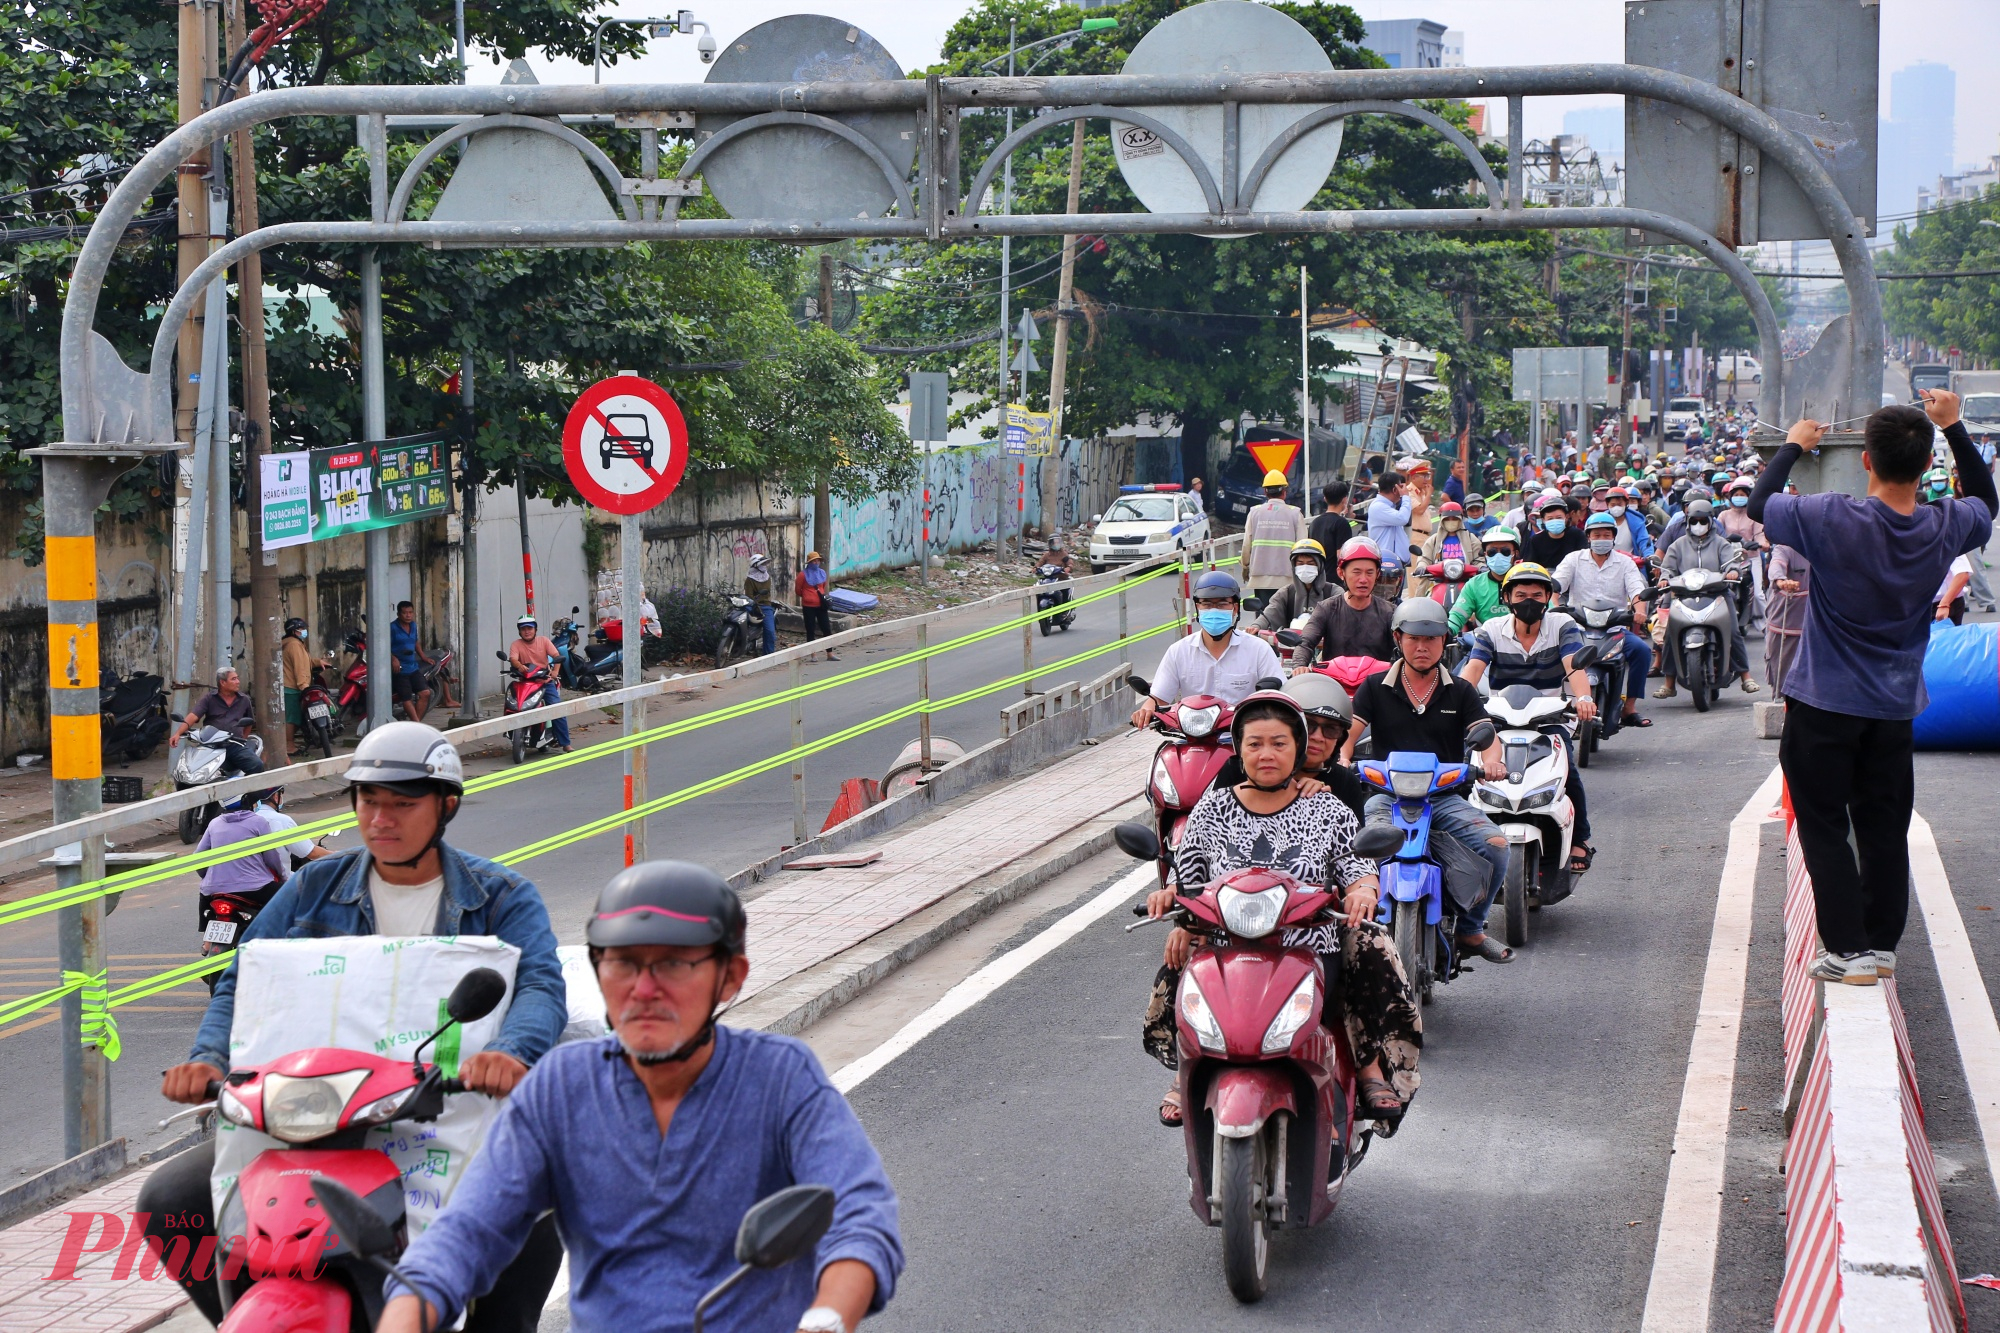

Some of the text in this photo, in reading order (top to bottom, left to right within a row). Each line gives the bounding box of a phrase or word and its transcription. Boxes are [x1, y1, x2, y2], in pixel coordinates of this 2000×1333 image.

[1128, 130, 1152, 144] X.X
[319, 467, 372, 501] BLACK
[264, 485, 307, 499] HOÀNG HÀ MOBILE
[340, 491, 355, 505] SALE
[428, 487, 446, 505] 66%
[403, 493, 413, 511] 6K
[269, 511, 278, 520] 243
[278, 508, 291, 521] BẠCH
[325, 495, 371, 528] WEEK
[1312, 706, 1341, 718] Andes
[210, 922, 233, 933] 55-X8
[208, 932, 230, 943] 9702
[279, 1168, 322, 1177] HONDA
